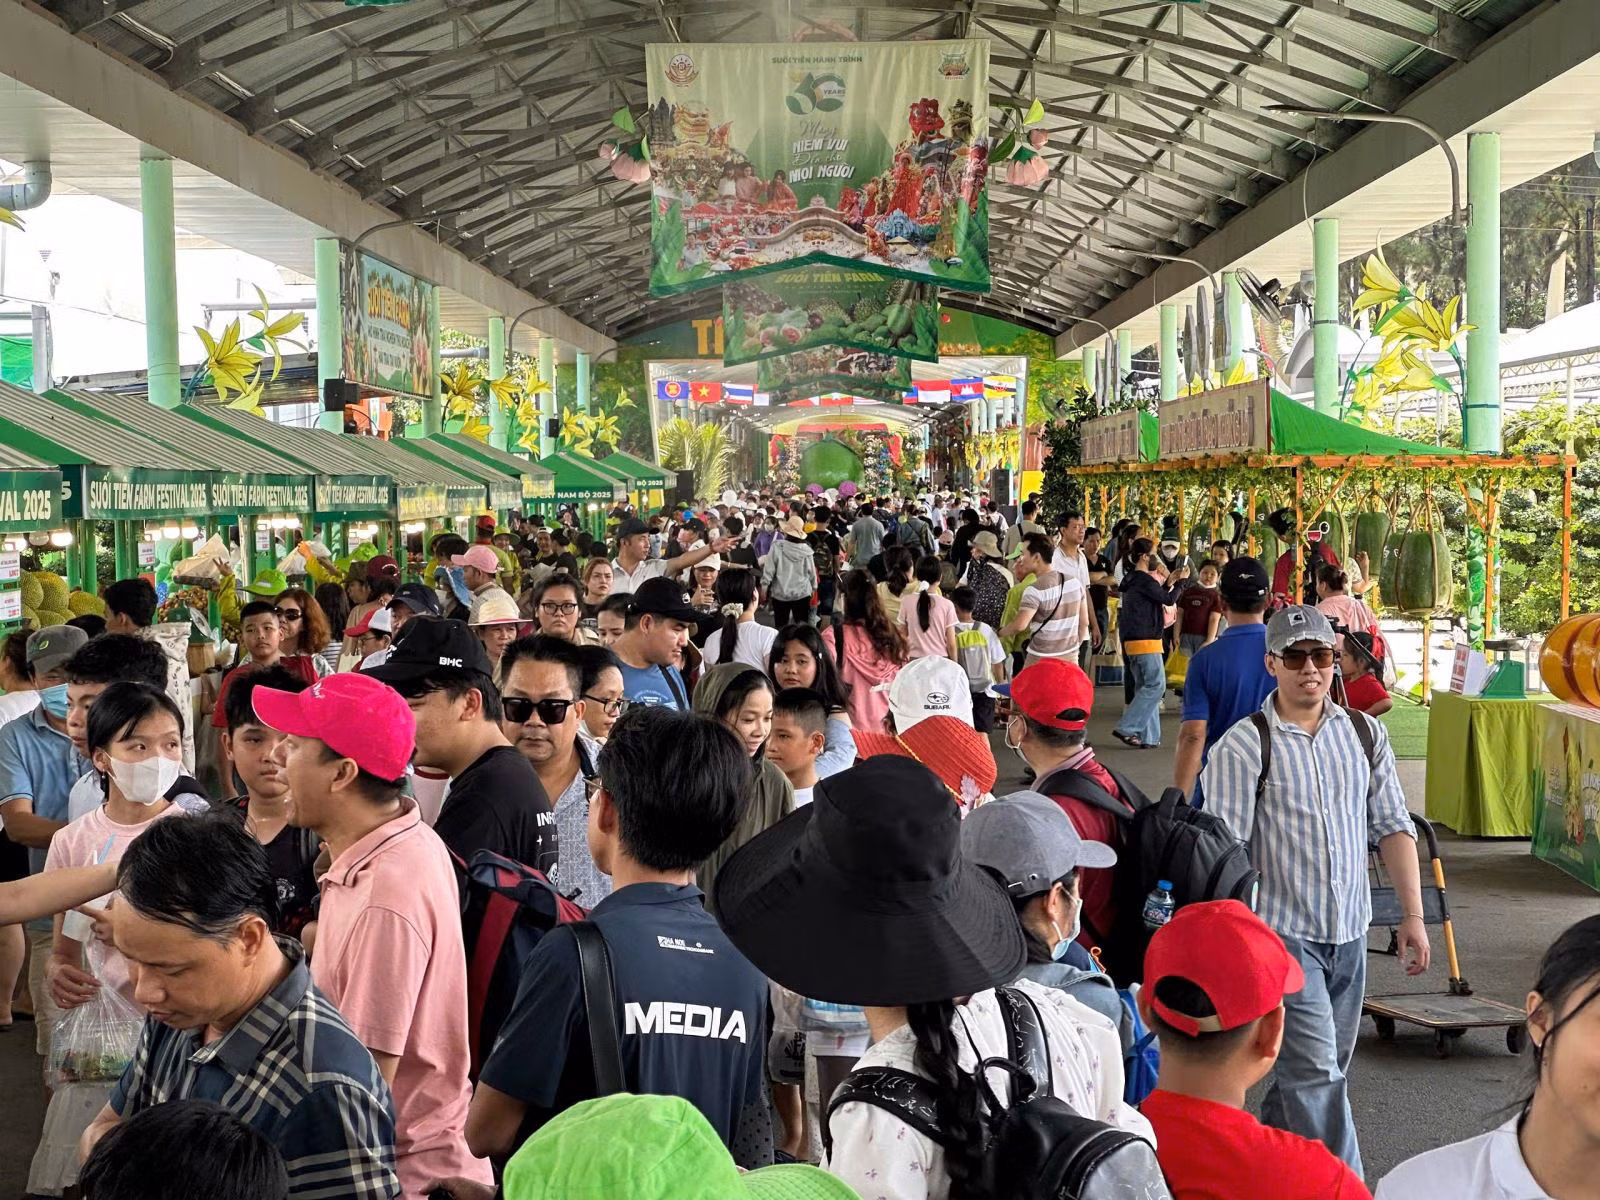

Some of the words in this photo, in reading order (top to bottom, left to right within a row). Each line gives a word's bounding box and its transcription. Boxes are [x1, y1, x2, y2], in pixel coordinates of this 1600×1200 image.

[826, 139, 849, 151] VUI
[789, 166, 813, 184] MỌI
[23, 489, 51, 520] 2025
[90, 471, 112, 510] SUỐI
[113, 475, 134, 510] TIÊN
[134, 484, 156, 510] FARM
[156, 483, 190, 509] FESTIVAL
[190, 483, 207, 508] 2025
[212, 475, 230, 507] SUỐI
[231, 478, 248, 507] TIÊN
[248, 485, 266, 507] FARM
[266, 485, 294, 507] FESTIVAL
[294, 485, 308, 507] 2025
[557, 491, 577, 499] NAM
[578, 490, 591, 500] BỘ
[624, 1001, 747, 1044] MEDIA
